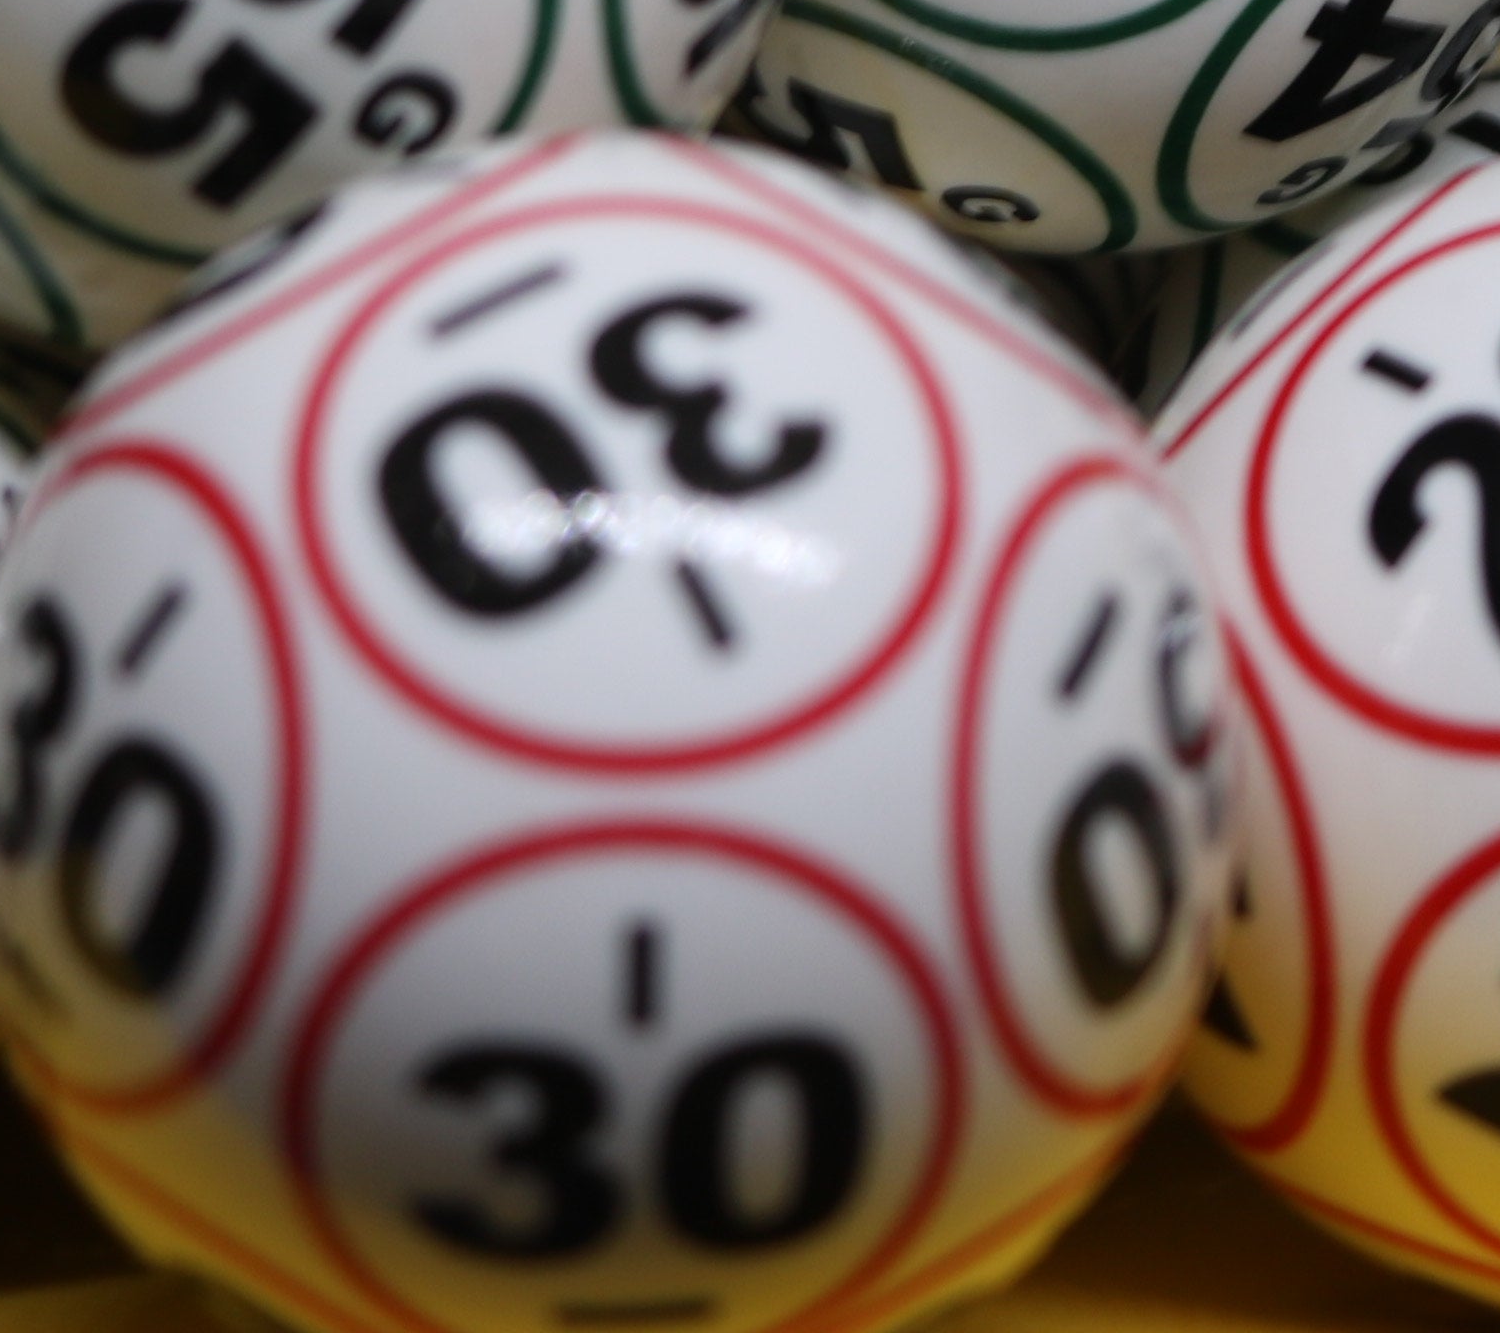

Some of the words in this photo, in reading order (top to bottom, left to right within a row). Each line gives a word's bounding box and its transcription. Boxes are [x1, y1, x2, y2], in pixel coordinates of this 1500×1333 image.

[350, 67, 458, 154] G
[375, 288, 832, 629] 30
[406, 1023, 879, 1265] 30
